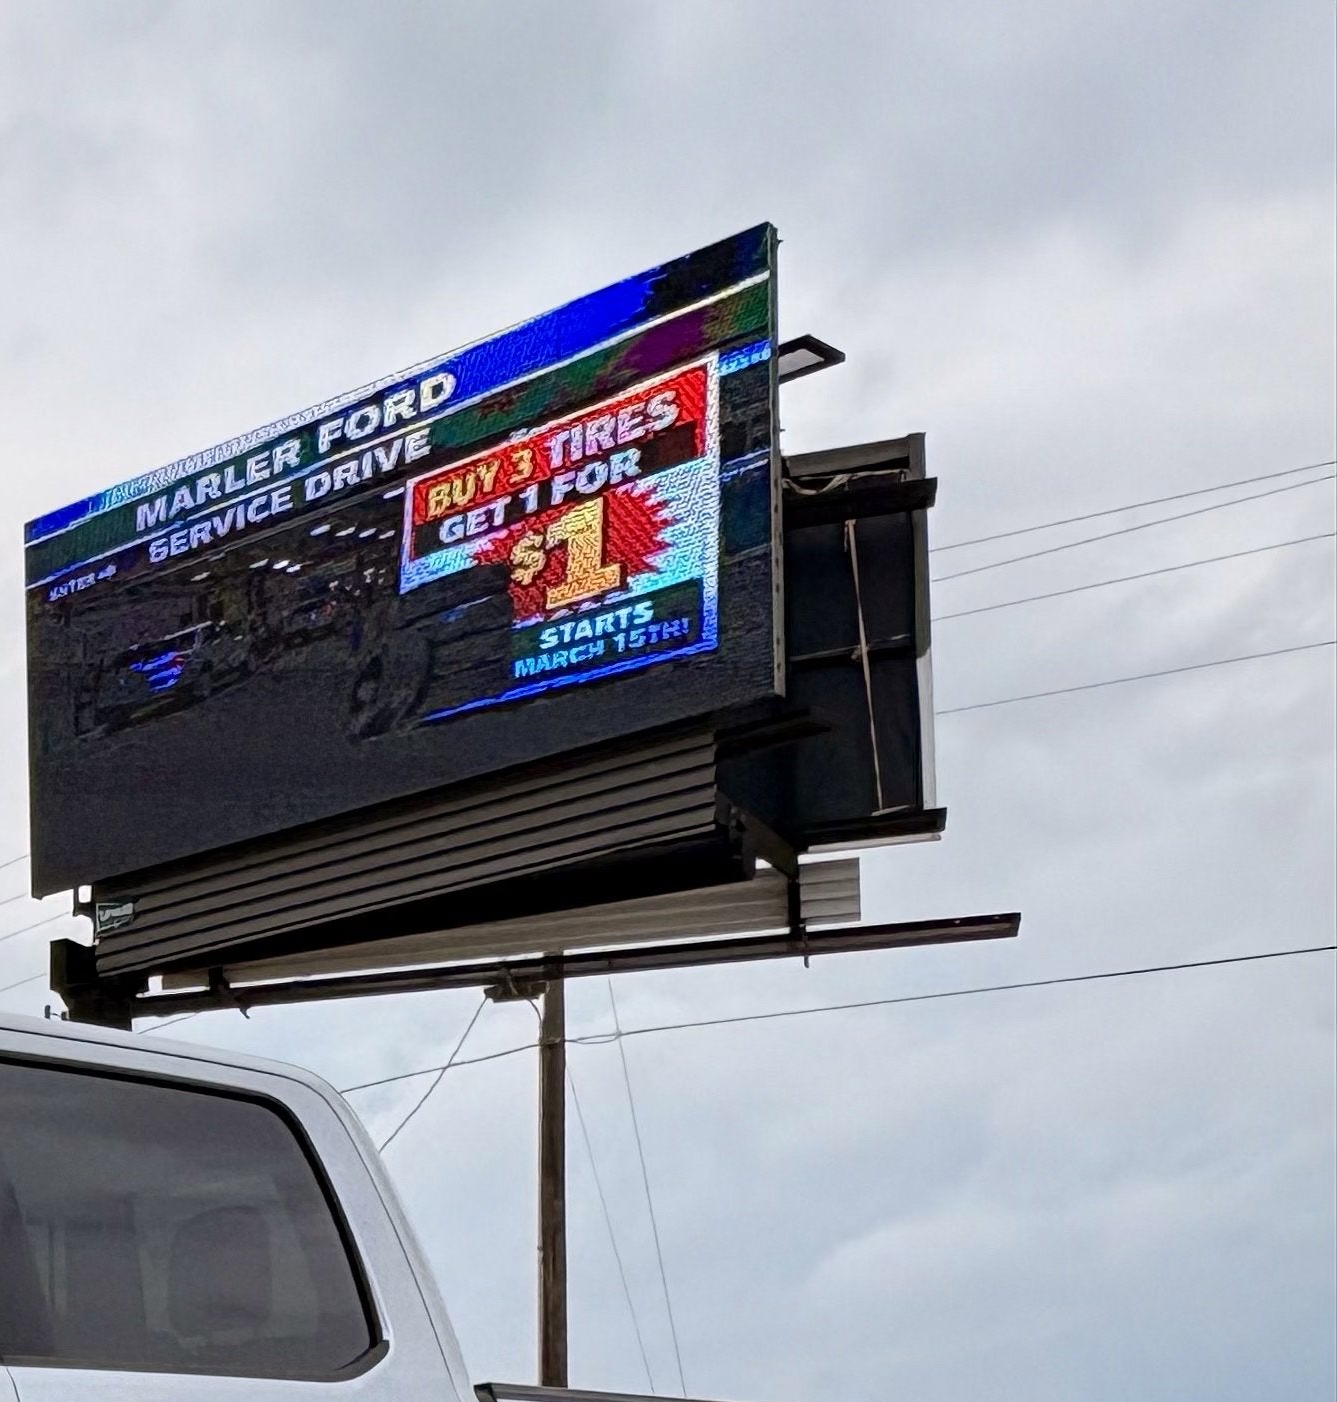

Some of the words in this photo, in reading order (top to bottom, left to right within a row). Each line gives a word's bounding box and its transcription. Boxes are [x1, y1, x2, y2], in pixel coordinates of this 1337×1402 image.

[136, 438, 302, 532] MARLER
[318, 372, 458, 454] FORD
[149, 486, 294, 564] SERVICE
[305, 427, 432, 502] DRIVE
[428, 456, 501, 518] BUY
[509, 448, 534, 484] 3
[545, 389, 680, 469] TIRES
[439, 495, 512, 544] GET
[519, 484, 540, 514] 1
[551, 447, 643, 505] FOR
[510, 496, 622, 610] $1
[514, 639, 606, 679] MARCH
[614, 617, 690, 653] 15TH!
[539, 600, 656, 650] STARTS
